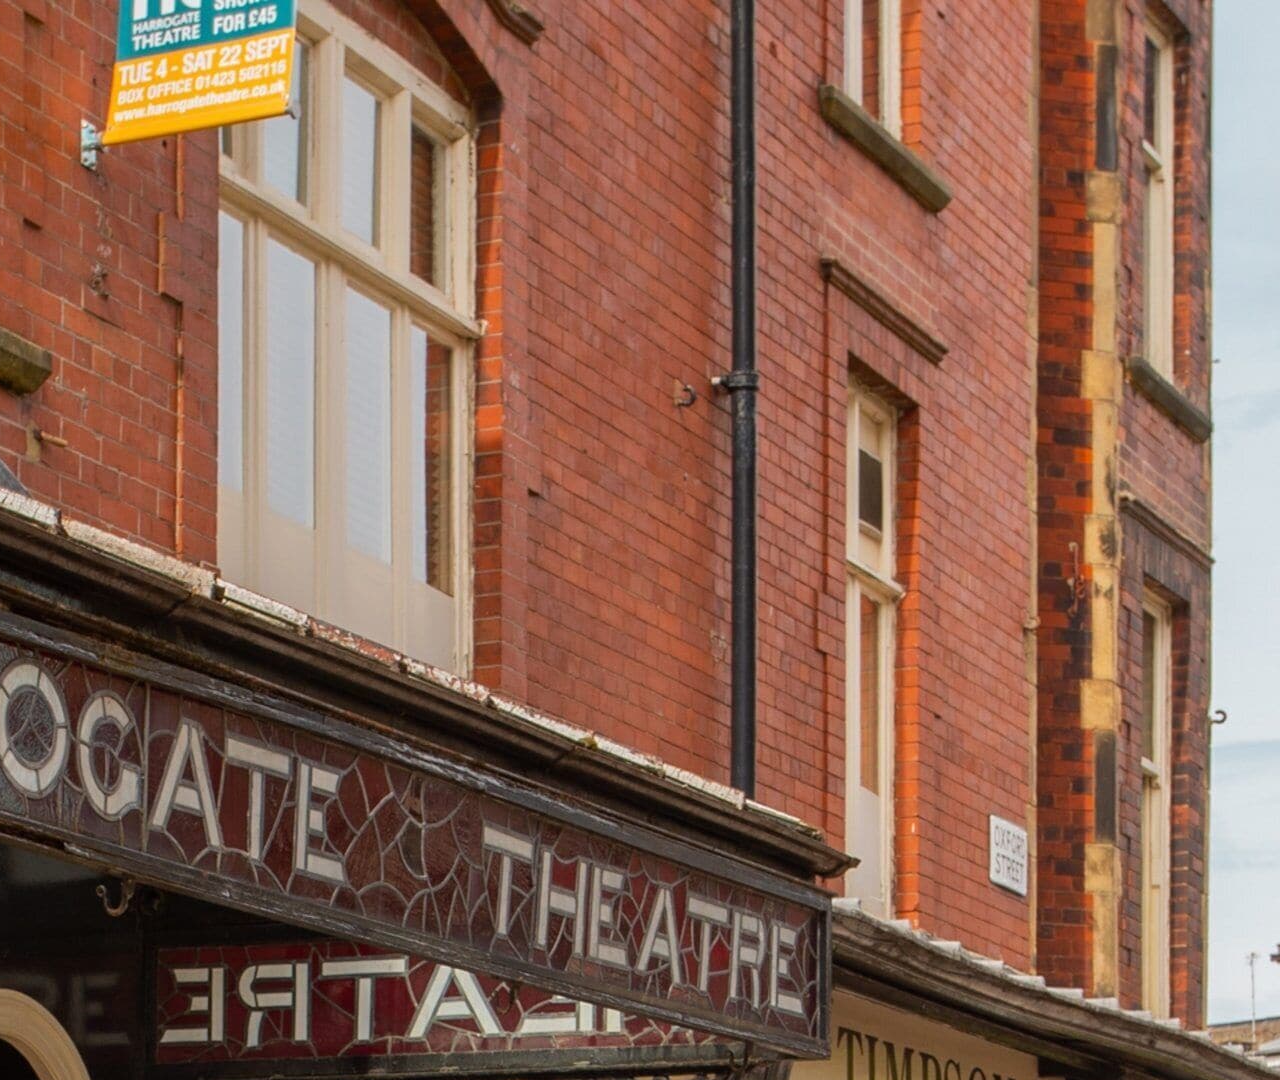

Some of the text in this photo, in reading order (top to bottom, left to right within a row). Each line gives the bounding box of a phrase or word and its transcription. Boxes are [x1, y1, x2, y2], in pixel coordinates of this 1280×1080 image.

[132, 11, 201, 35] HARROGATE
[213, 6, 277, 35] FOR £45
[131, 24, 201, 51] THEATRE
[120, 61, 152, 86] TUE
[157, 61, 168, 79] 4
[182, 50, 215, 74] SAT
[219, 45, 241, 67] 22
[245, 33, 290, 62] SEPT
[117, 86, 144, 106] BOX
[147, 77, 192, 100] OFFICE
[195, 71, 236, 91] 01423
[482, 826, 808, 1016] THEATRE
